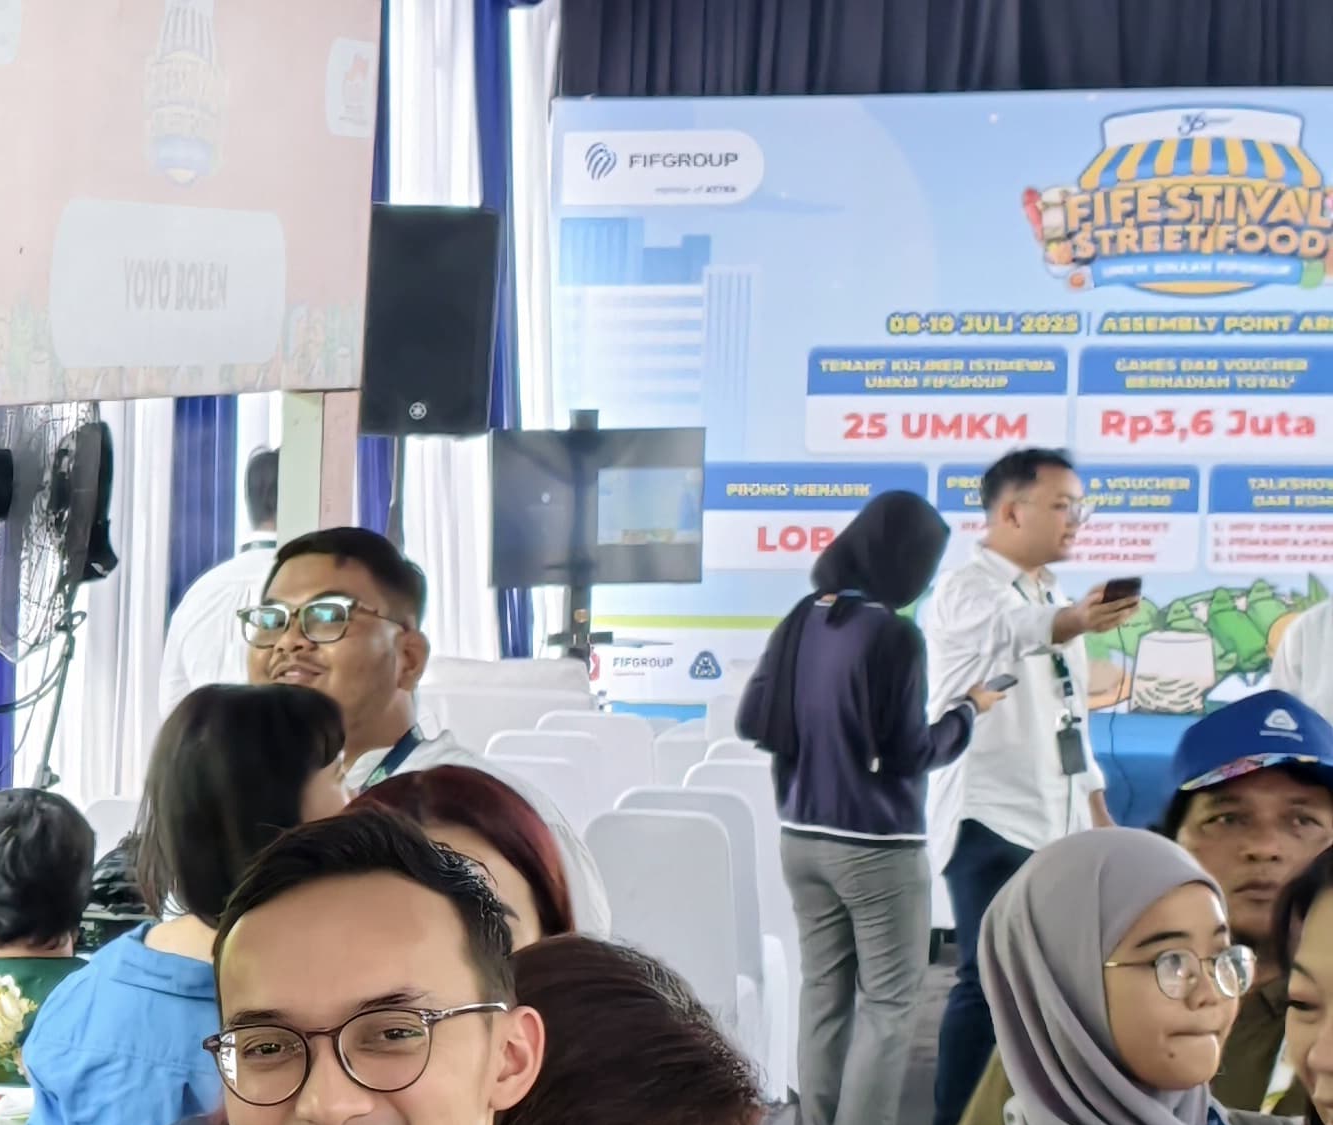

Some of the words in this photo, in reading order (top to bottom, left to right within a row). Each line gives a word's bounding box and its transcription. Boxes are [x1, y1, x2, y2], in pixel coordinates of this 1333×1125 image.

[628, 152, 739, 169] FIFGROUP
[1065, 184, 1333, 232] FIFESTIVAL
[1072, 222, 1205, 260] STREET
[1215, 224, 1330, 258] FOOD
[123, 257, 171, 312] YOYO
[174, 260, 229, 312] BOLEN
[889, 313, 955, 334] 08-10
[961, 313, 1014, 334] JULI
[1101, 315, 1218, 333] ASSEMBLY
[1223, 315, 1293, 333] POINT
[819, 358, 886, 373] TENANT
[969, 358, 1055, 373] ISTIMEWA
[1114, 358, 1177, 372] GAMES
[1224, 358, 1309, 372] VOUCHER
[842, 412, 888, 440] 25
[900, 412, 1029, 440] UMKM
[1099, 409, 1216, 444] Rp3,6
[1224, 409, 1318, 438] Juta
[725, 483, 790, 498] PROMO
[1107, 477, 1191, 490] VOUCHER
[613, 657, 674, 669] FIFGROUP
